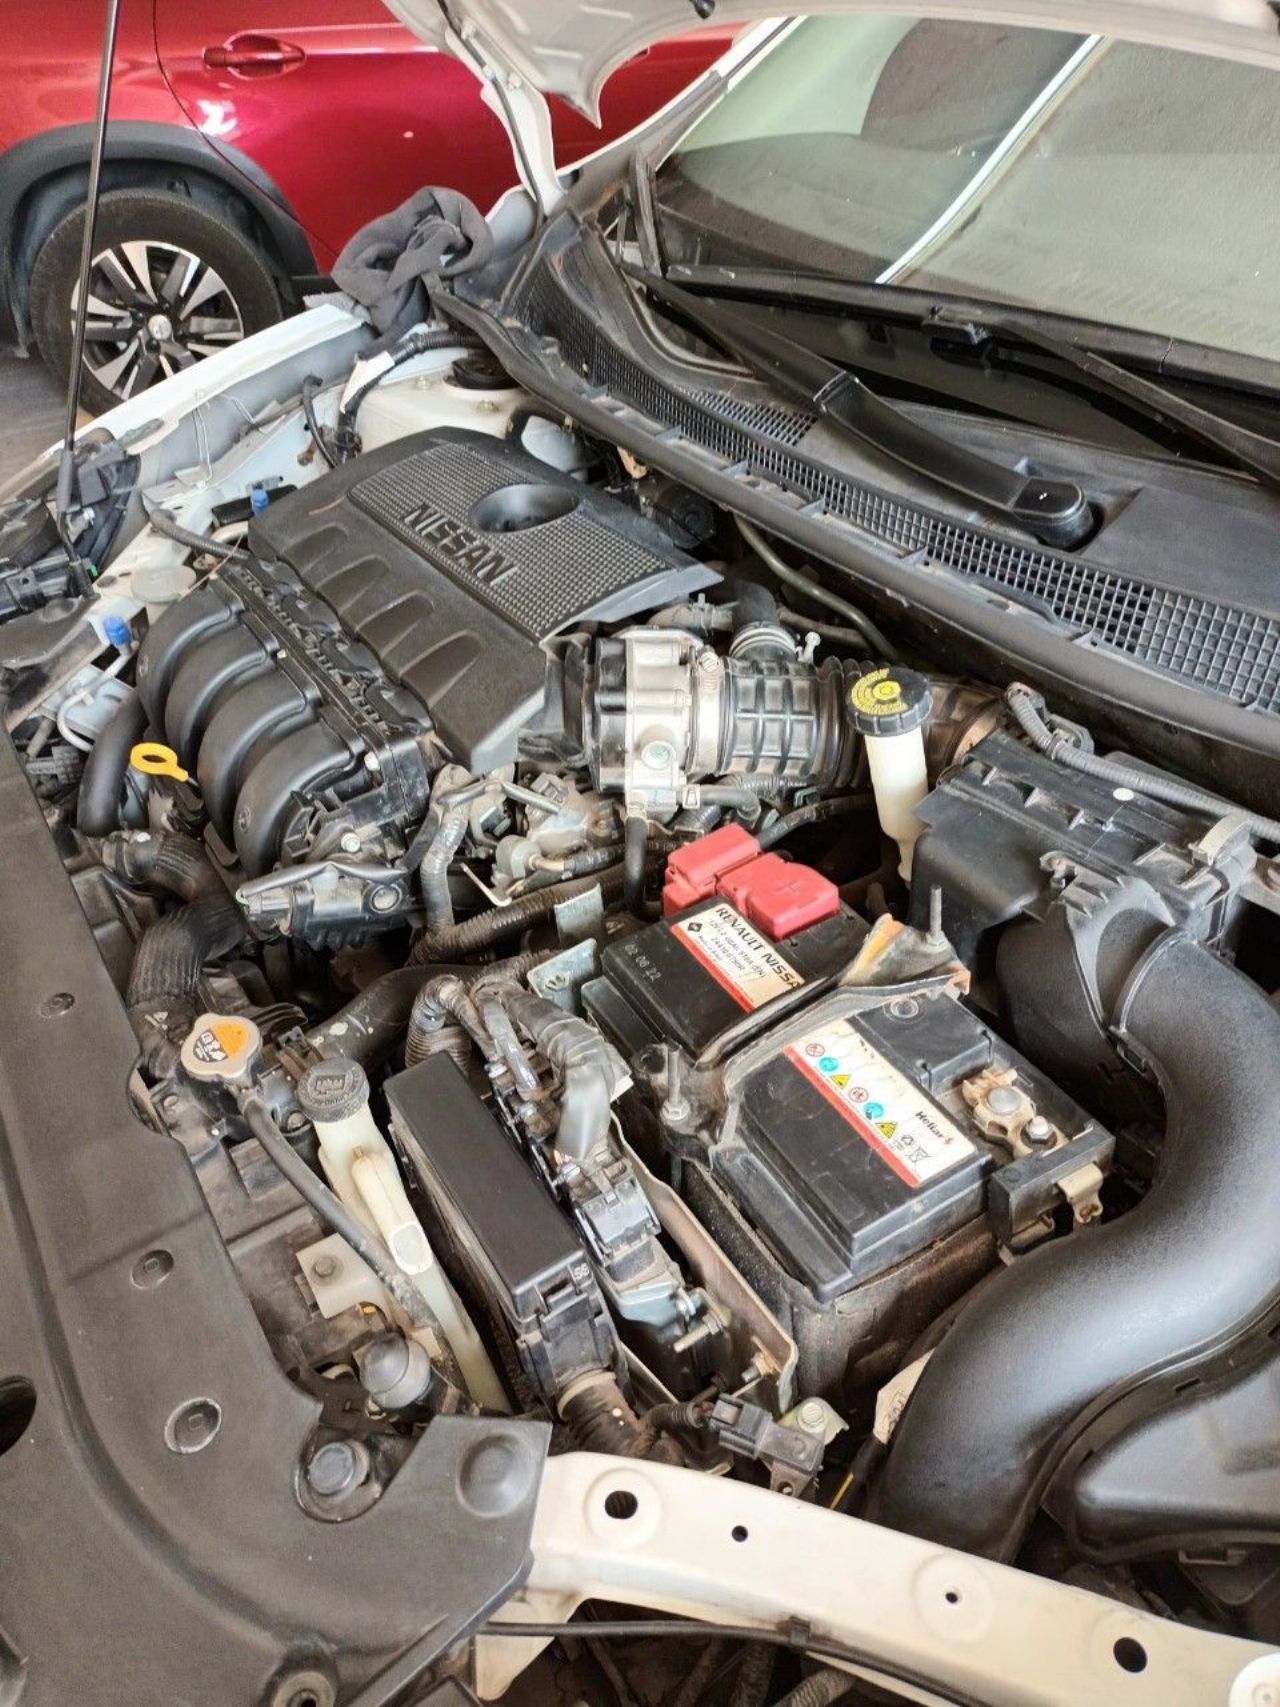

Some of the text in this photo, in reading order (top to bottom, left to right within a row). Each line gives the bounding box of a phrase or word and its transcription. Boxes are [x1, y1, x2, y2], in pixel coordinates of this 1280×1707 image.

[404, 503, 519, 587] NISSAN
[716, 908, 764, 951] RENAULT
[915, 1110, 944, 1138] Heliar
